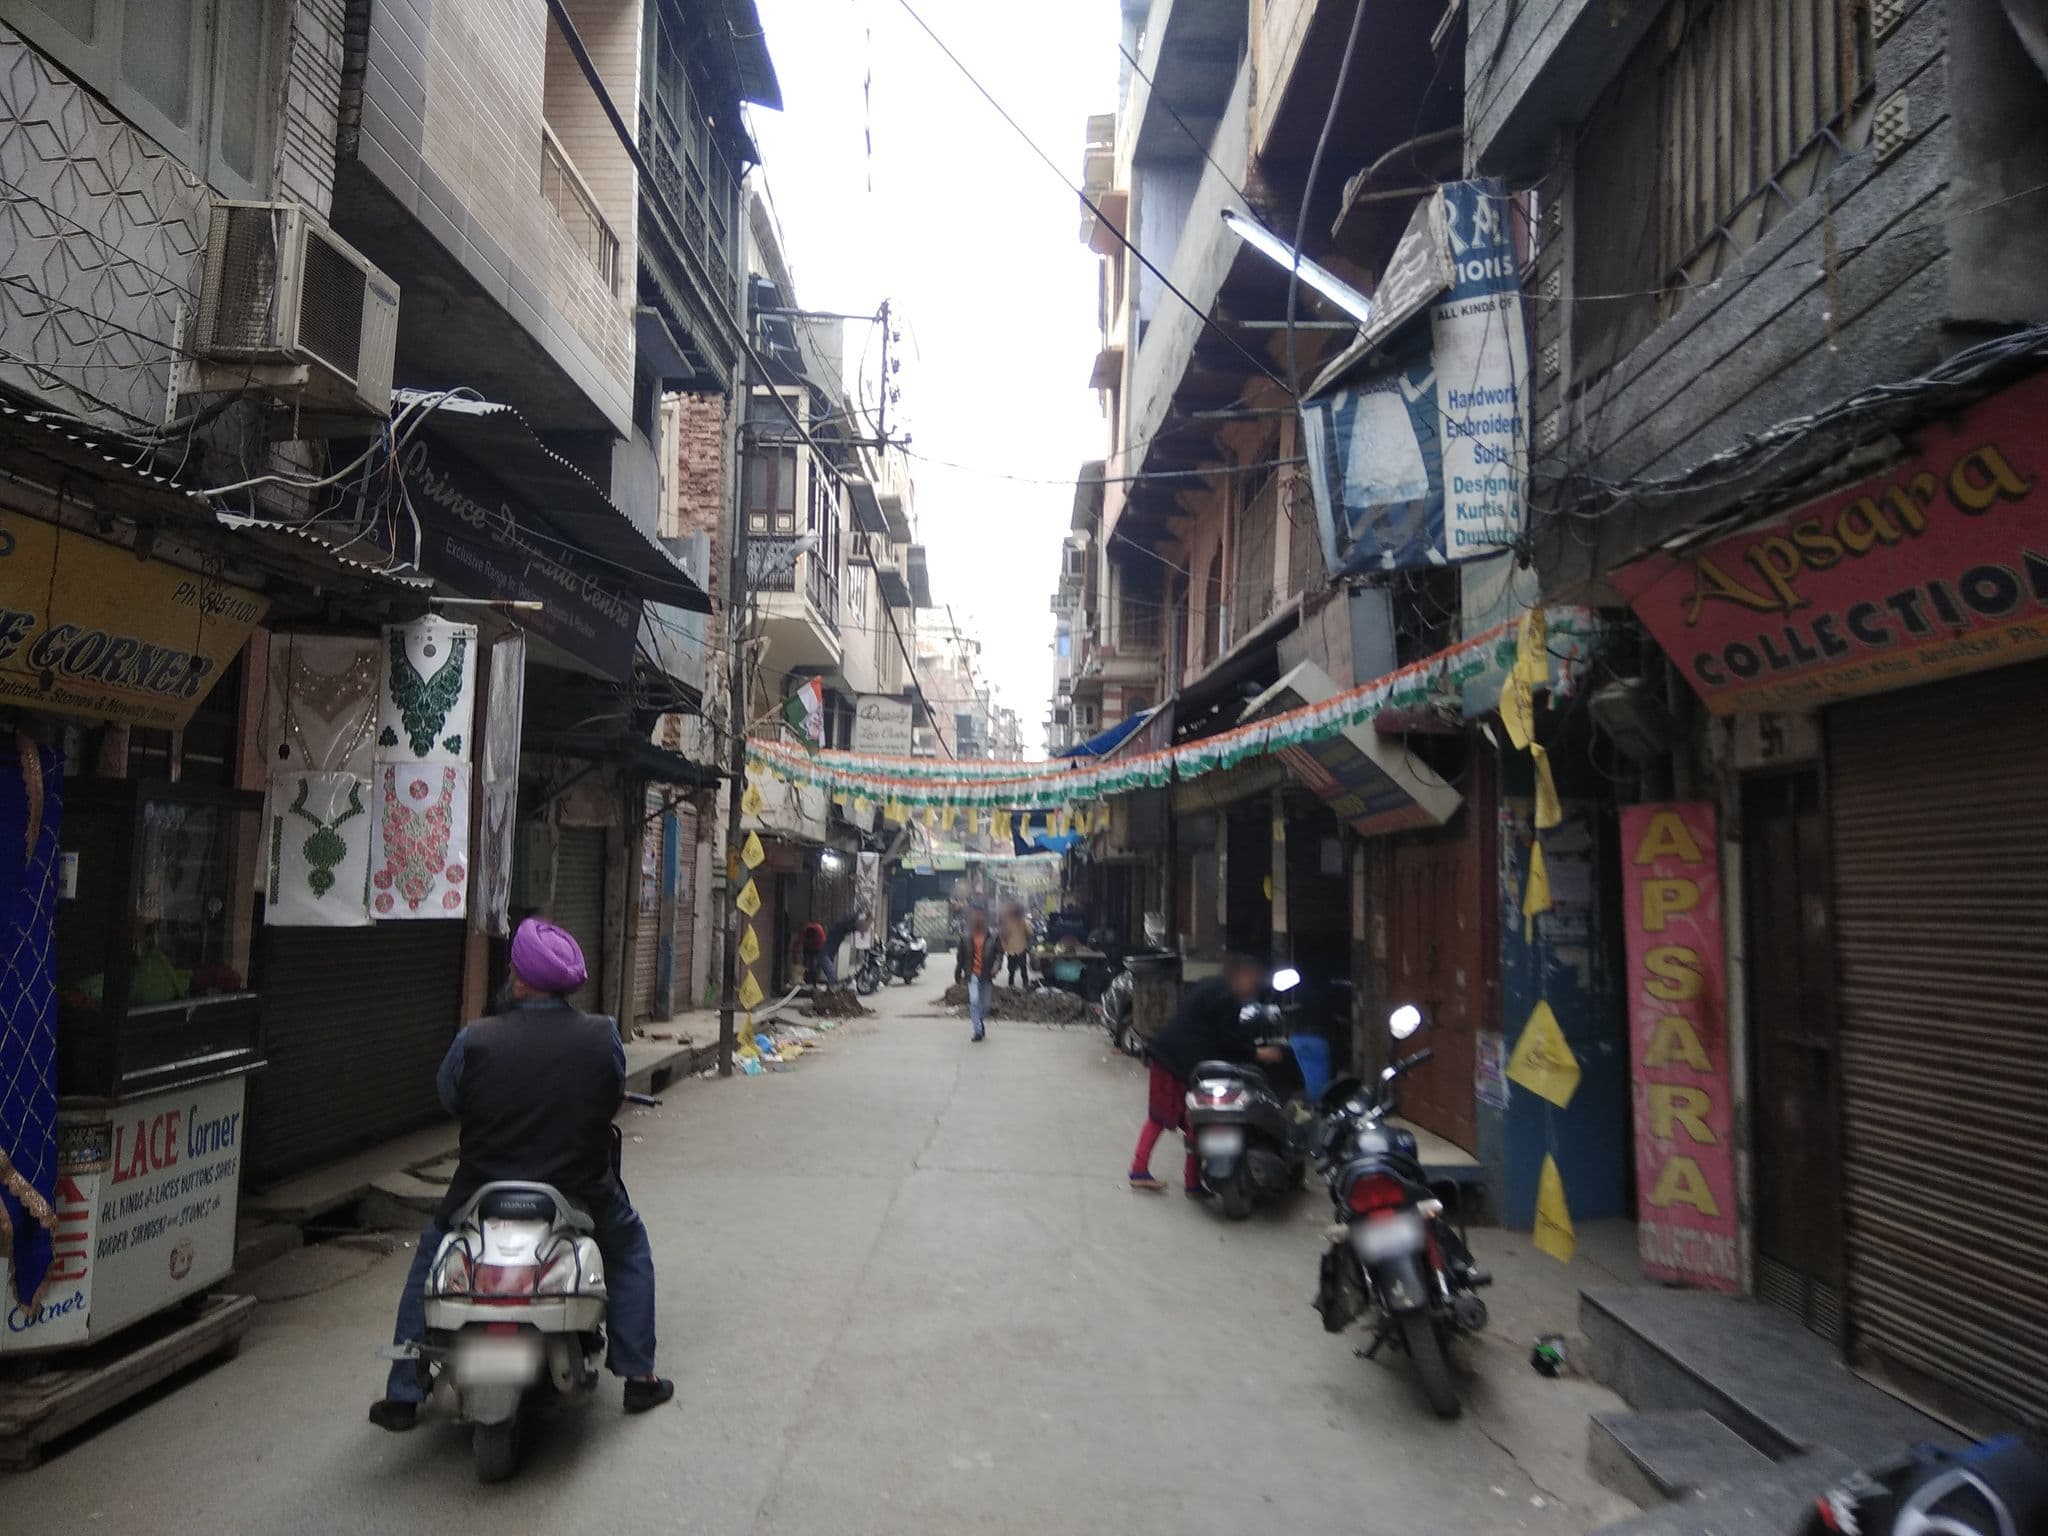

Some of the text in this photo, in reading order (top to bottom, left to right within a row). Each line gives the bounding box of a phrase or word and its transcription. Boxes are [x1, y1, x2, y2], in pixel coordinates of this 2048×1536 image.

[1453, 255, 1514, 283] IONS
[1438, 307, 1458, 321] ALL
[1460, 300, 1495, 317] KINDS
[1448, 384, 1518, 411] Handwork
[1446, 413, 1522, 440] Embroidery
[1473, 443, 1508, 466] Suits
[1456, 501, 1505, 520] Kurtis
[1683, 445, 2036, 627] Apsara
[445, 537, 485, 573] Exclusive
[581, 573, 630, 628] Centre
[28, 622, 216, 699] CORNER
[1632, 809, 1722, 1217] APSARA
[112, 1109, 182, 1185] LACE
[188, 1103, 240, 1160] Corner
[101, 1199, 118, 1224] ALL
[119, 1189, 144, 1218] KINDS
